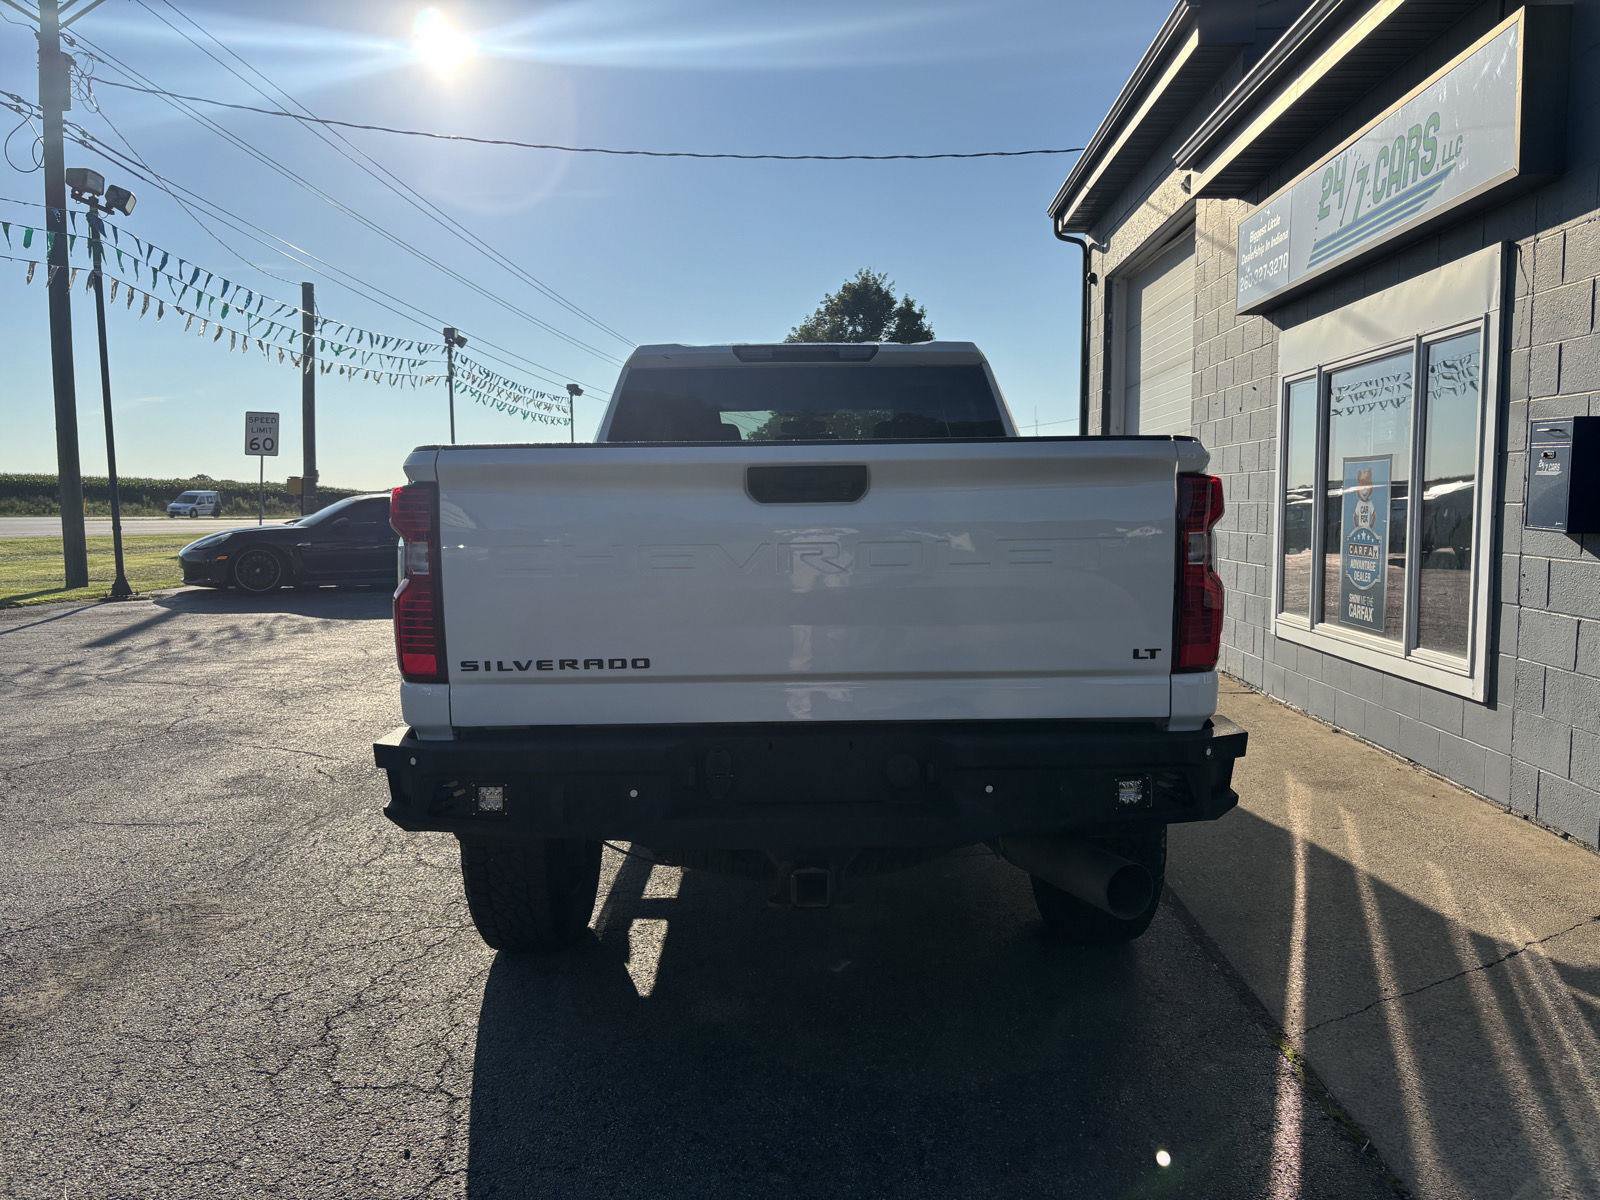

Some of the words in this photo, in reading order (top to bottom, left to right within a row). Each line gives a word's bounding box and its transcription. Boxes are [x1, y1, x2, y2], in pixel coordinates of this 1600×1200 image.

[1441, 134, 1464, 167] LLC
[248, 416, 277, 424] SPEED
[250, 437, 274, 451] 60
[1360, 505, 1369, 514] CAR
[1349, 545, 1379, 559] CARFAX
[1350, 558, 1376, 572] ADVANTAGE
[1353, 570, 1371, 583] DEALER
[1348, 603, 1374, 623] CARFAX
[1132, 648, 1162, 660] LT
[460, 657, 651, 672] SILVERADO
